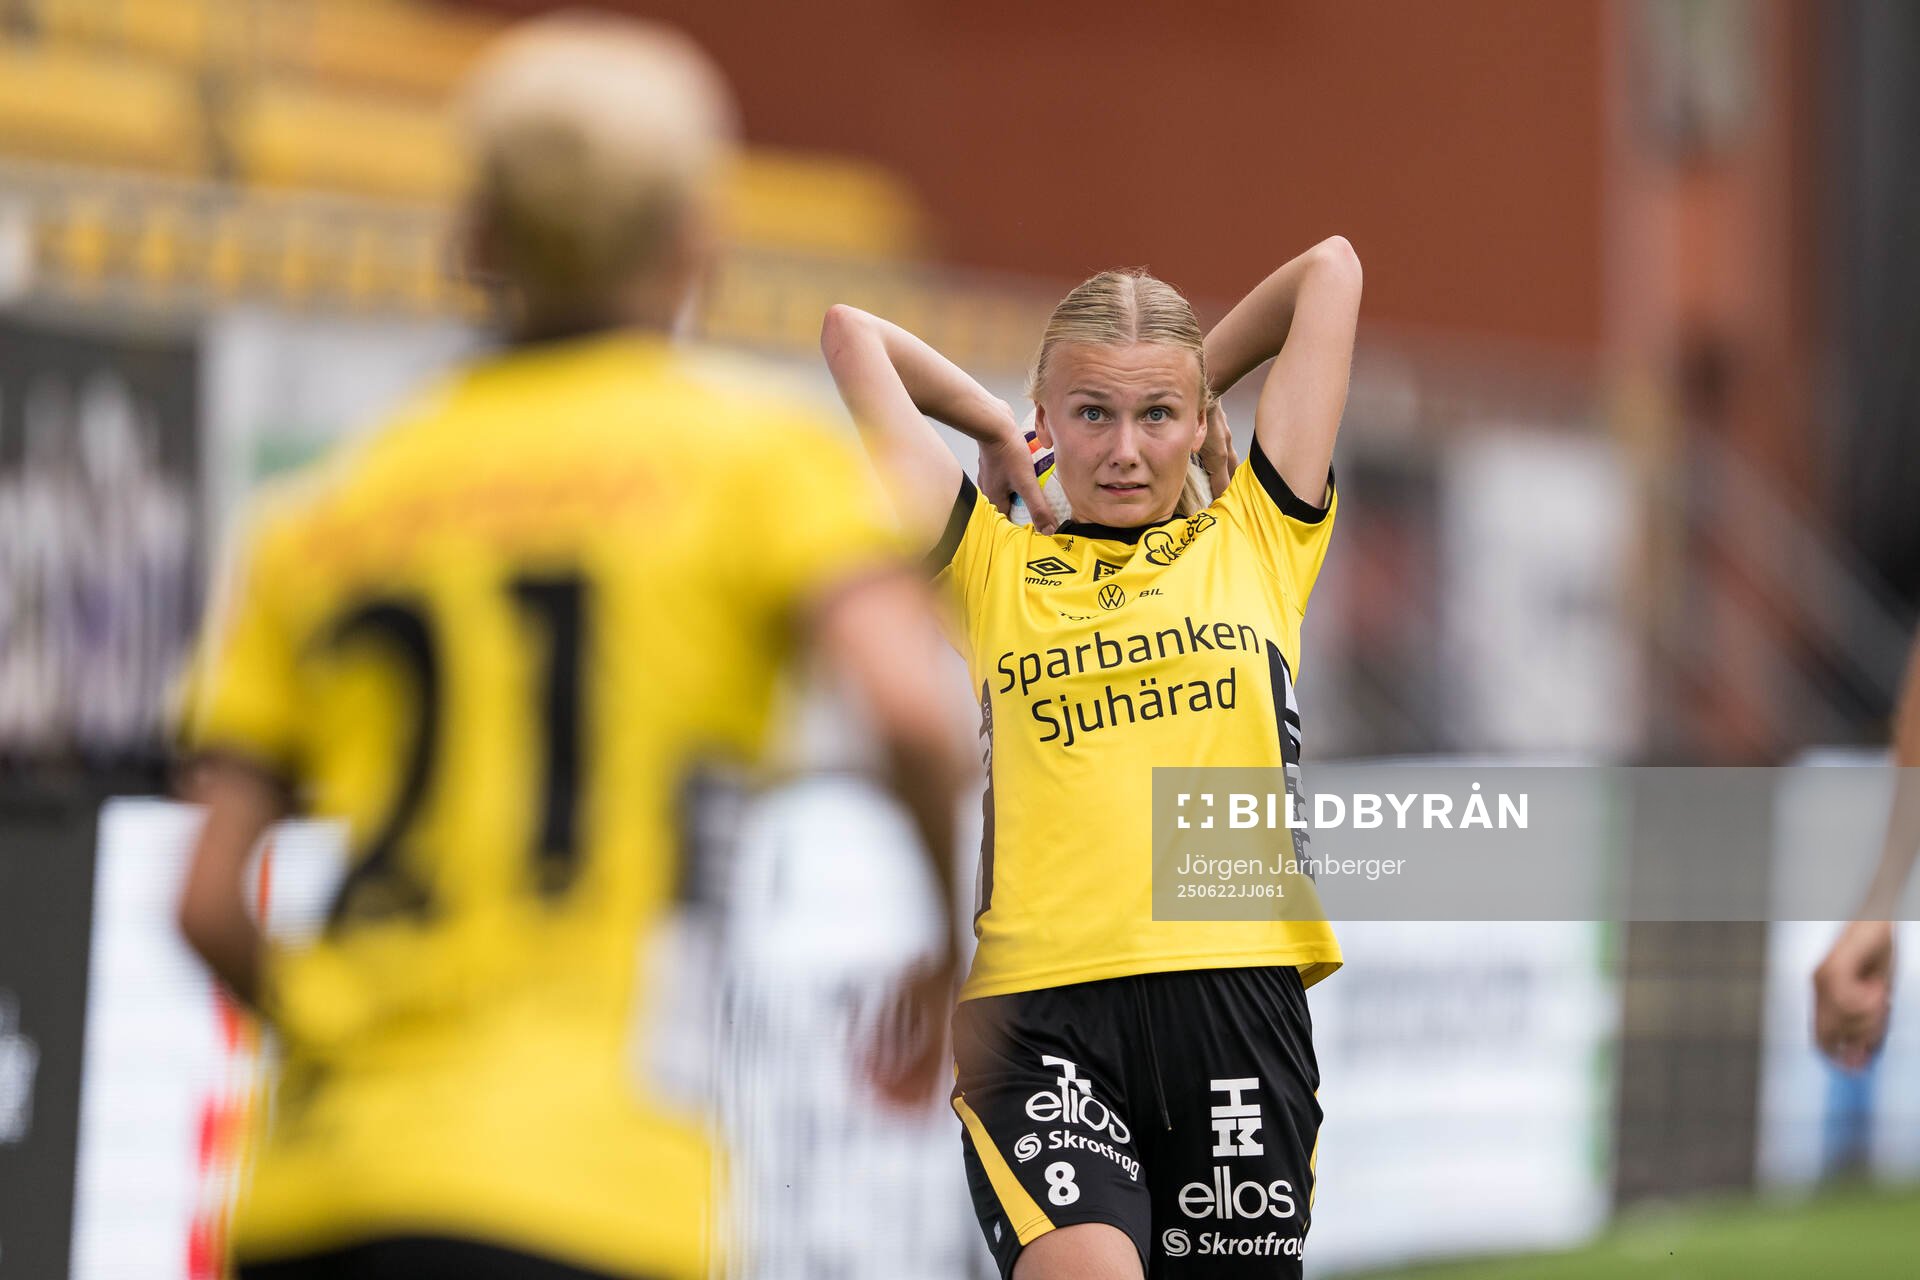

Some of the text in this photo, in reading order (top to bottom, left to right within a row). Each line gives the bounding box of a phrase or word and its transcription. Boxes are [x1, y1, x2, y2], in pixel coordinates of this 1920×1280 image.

[1139, 588, 1164, 598] BIL
[998, 617, 1259, 697] Sparbanken
[1031, 667, 1236, 747] Sjuhärad
[308, 568, 590, 935] 21
[1048, 1130, 1140, 1182] Skrotfrag
[1044, 1161, 1081, 1206] 8
[1178, 1166, 1296, 1219] ellos
